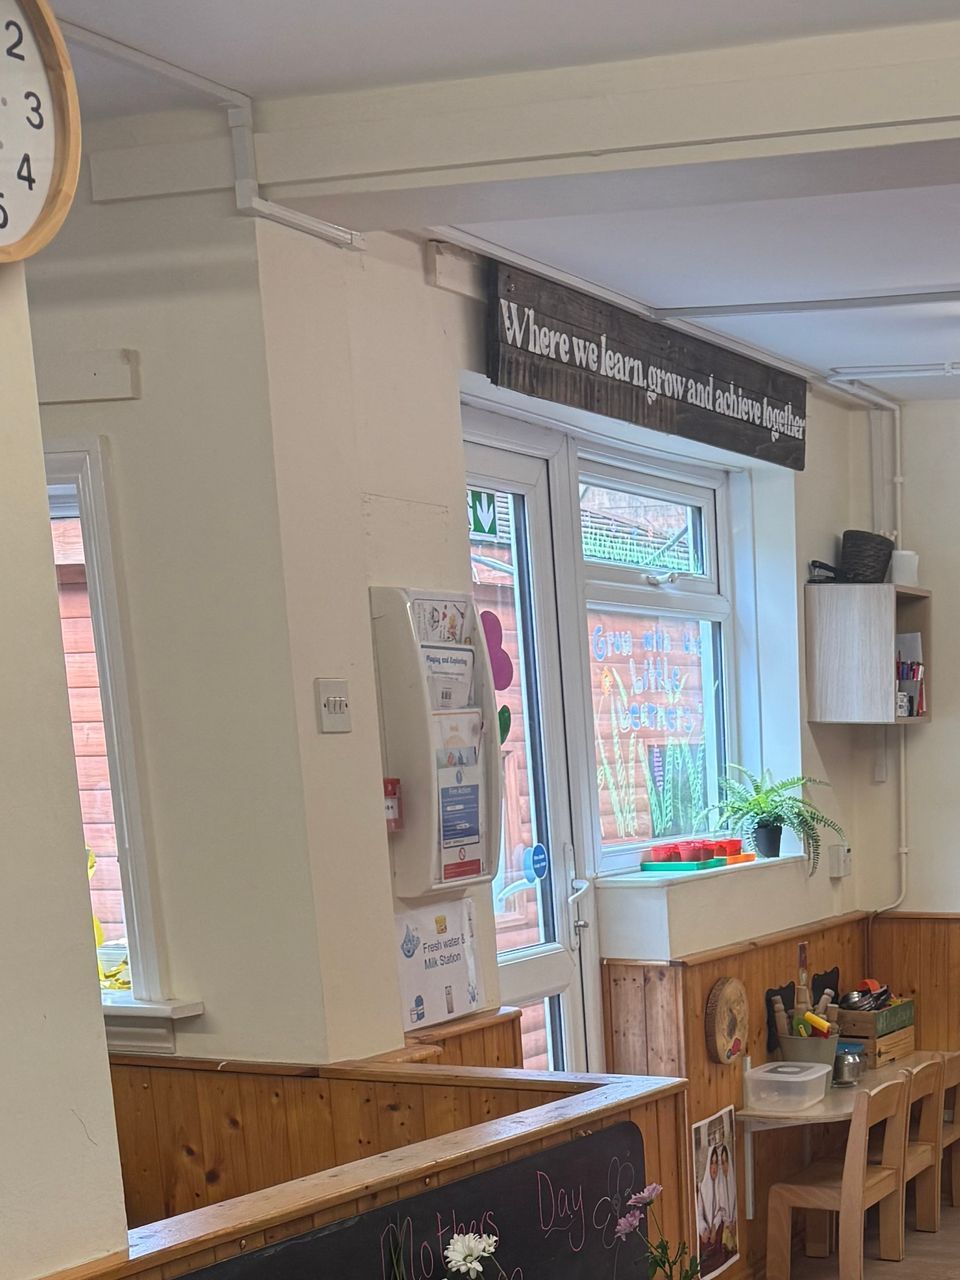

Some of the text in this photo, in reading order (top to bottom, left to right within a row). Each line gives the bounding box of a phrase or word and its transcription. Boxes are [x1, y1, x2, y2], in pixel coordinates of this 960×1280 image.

[5, 20, 25, 61] 2
[24, 91, 44, 130] 3
[16, 153, 36, 190] 4
[500, 298, 806, 442] Where we learn, grow and achieve together
[423, 940, 442, 954] Fresh
[444, 936, 460, 948] water
[424, 952, 461, 970] Milk Station
[536, 1171, 586, 1252] Day
